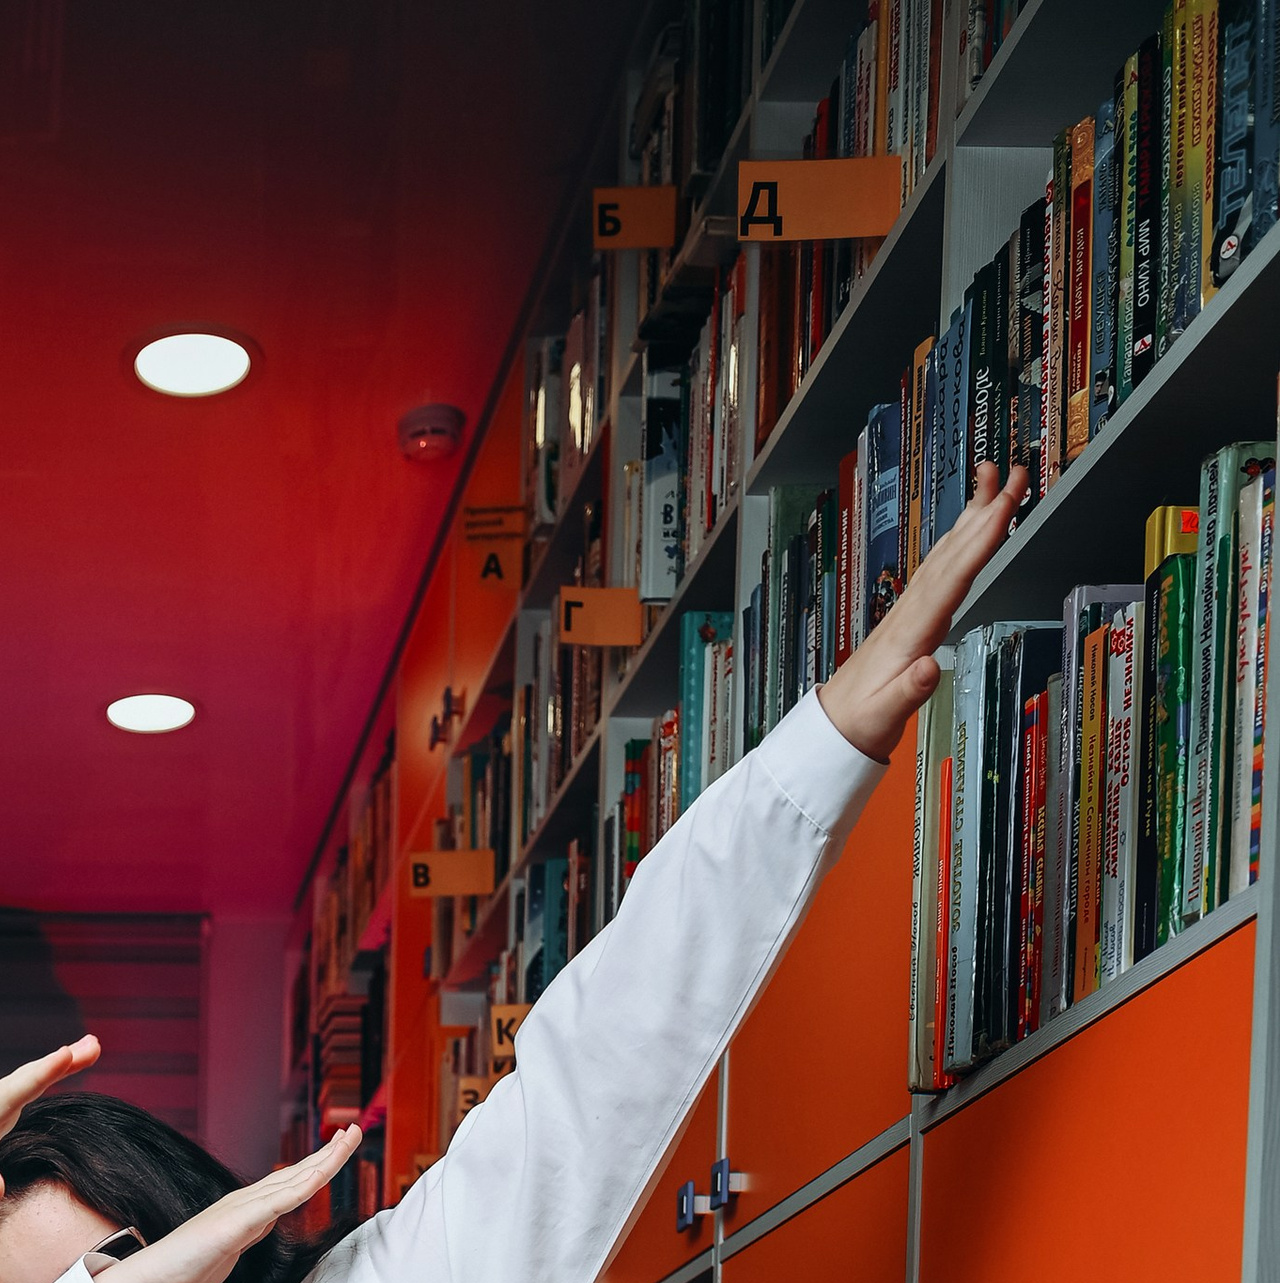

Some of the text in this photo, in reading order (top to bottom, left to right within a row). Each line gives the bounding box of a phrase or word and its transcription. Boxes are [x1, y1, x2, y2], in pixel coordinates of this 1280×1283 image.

[1204, 10, 1216, 204] РОВНО В ПОЛНОЧЬ
[1219, 21, 1252, 230] ТЕЛЕПАТ
[598, 203, 621, 237] Б
[740, 181, 783, 236] Д
[1170, 203, 1183, 270] Крюкова
[1043, 211, 1052, 275] ДРУЗЬЯ
[1074, 227, 1085, 321] КУБОК ЧАРОДЕЯ
[1137, 218, 1150, 308] МИР КИНО
[1188, 180, 1201, 306] Тамара Крюкова
[1042, 310, 1050, 322] И
[1123, 269, 1134, 388] Тамара Крюкова
[936, 314, 965, 504] Тамара Крюкова
[1040, 327, 1049, 429] МОСКВИЧЕВ
[482, 553, 503, 578] А
[838, 508, 849, 651] БРОНЗОВЫЙ МАЛЬЧИК
[565, 601, 583, 631] Г
[1090, 643, 1098, 687] Николай
[1187, 459, 1219, 903] Николай Приключения Незнайки и его друзей
[1254, 623, 1266, 727] Николай Носов
[1089, 688, 1097, 722] Носов
[1147, 694, 1157, 770] Незнайка
[1024, 732, 1032, 774] Городе
[1087, 734, 1096, 793] Незнайка
[1146, 774, 1153, 793] на
[1023, 775, 1031, 831] Каменном
[1144, 798, 1154, 838] Луне
[910, 750, 924, 952] Носов ЖИВОЕ ПЛАМЯ
[1021, 840, 1029, 895] Незнайка
[1069, 797, 1081, 921] ЖИВАЯ ШЛЯПА
[1085, 805, 1095, 876] Солнечном
[413, 864, 430, 887] В
[947, 721, 969, 1058] Николай Носов ЗОЛОТЫЕ СТРАНИЦЫ
[497, 1018, 515, 1045] К
